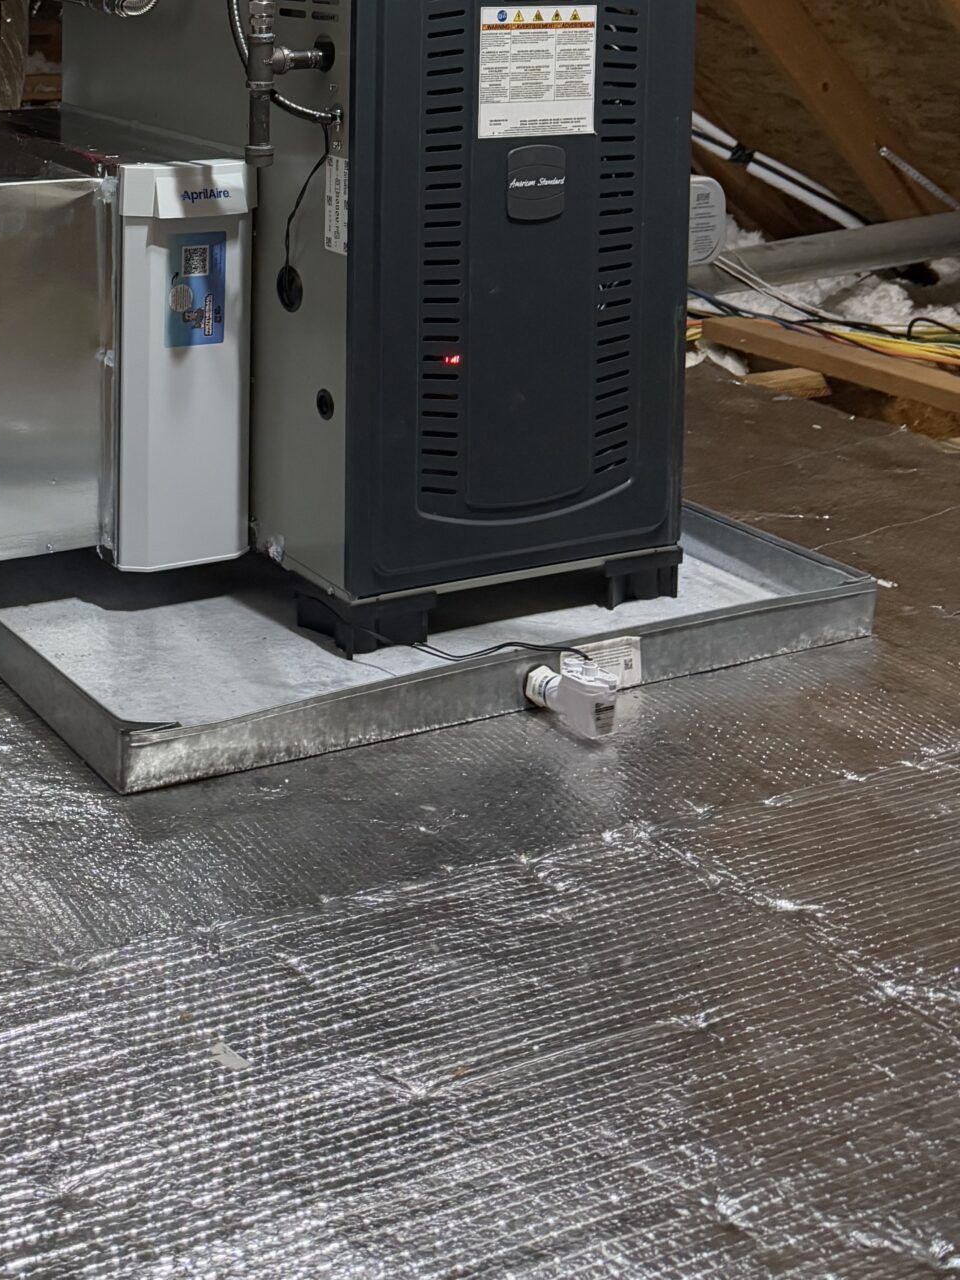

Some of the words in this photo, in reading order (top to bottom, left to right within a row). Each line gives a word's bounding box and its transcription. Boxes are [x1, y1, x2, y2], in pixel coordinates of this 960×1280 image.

[509, 178, 536, 188] American
[537, 176, 566, 186] Standard
[181, 188, 230, 203] AprilAire
